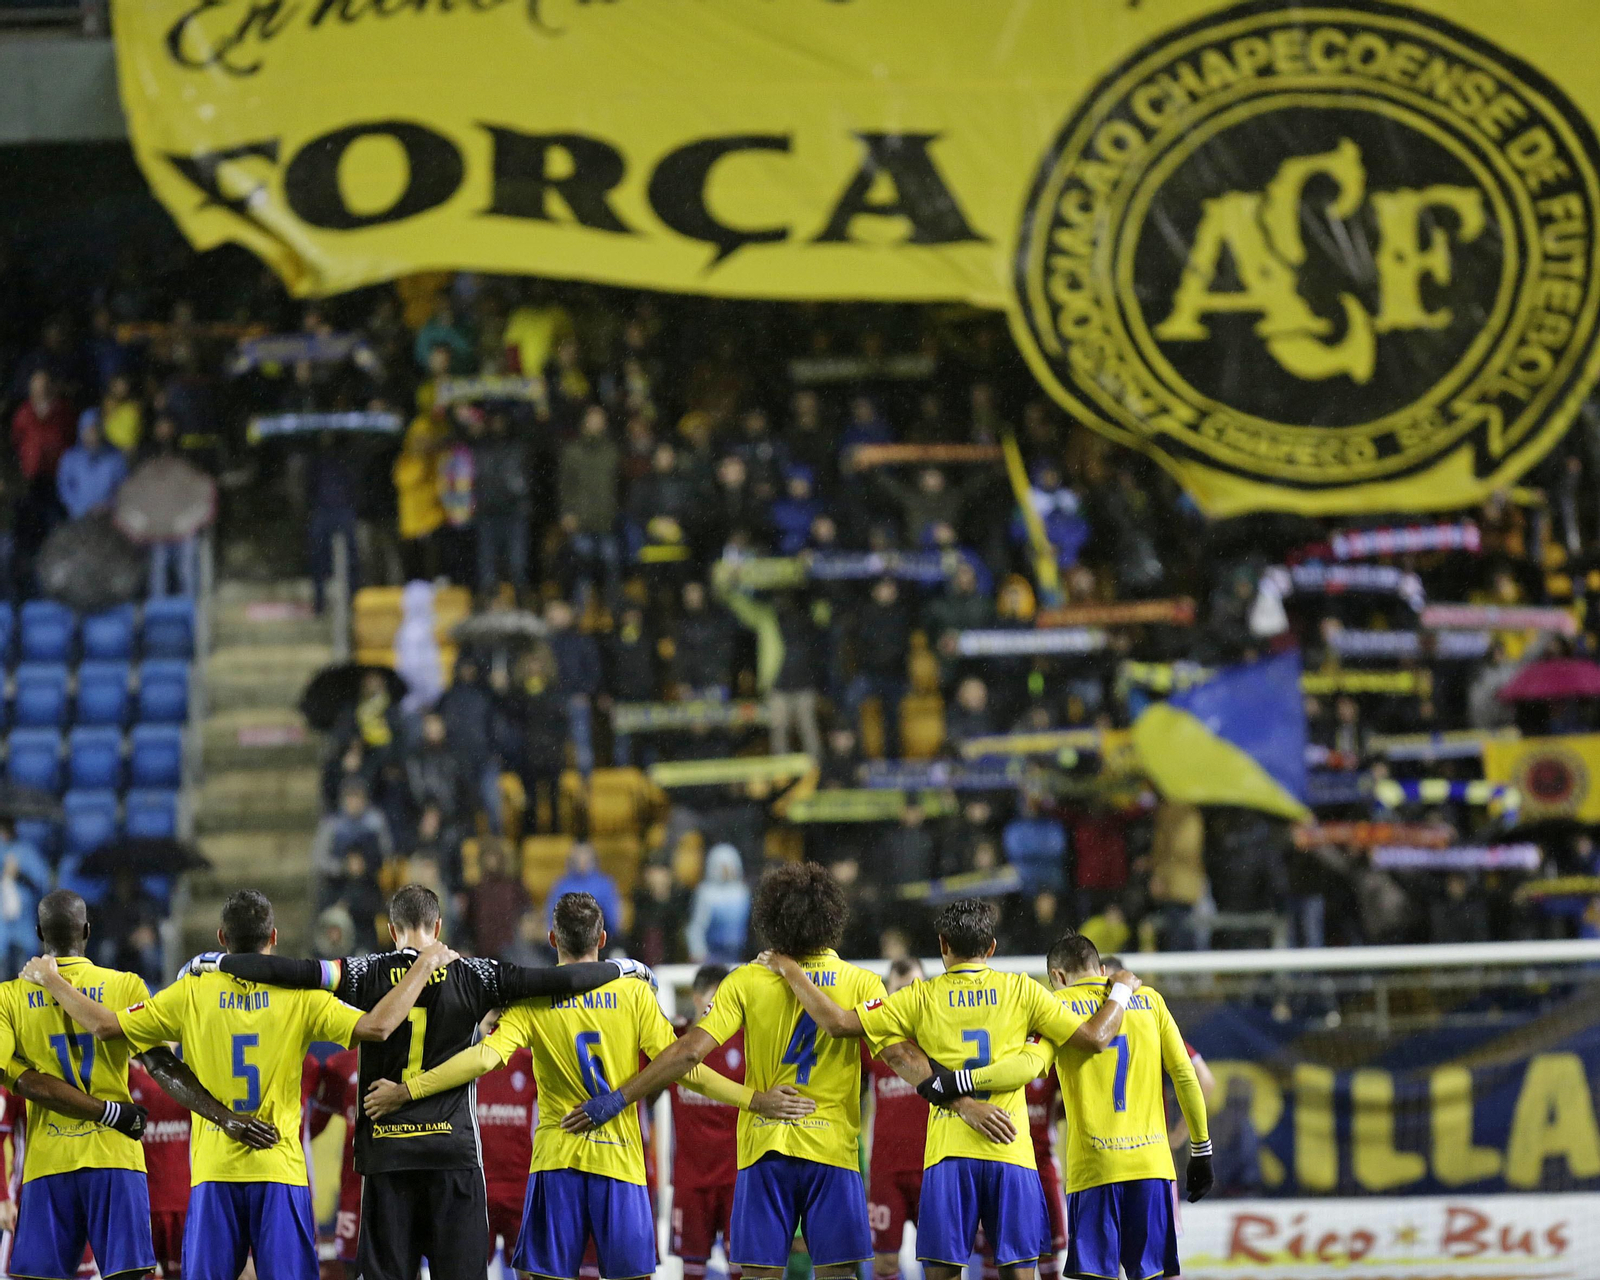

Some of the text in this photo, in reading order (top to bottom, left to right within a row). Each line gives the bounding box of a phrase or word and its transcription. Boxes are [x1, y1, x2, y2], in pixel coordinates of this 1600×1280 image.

[1133, 27, 1526, 138] CHAPECOENSE
[1505, 127, 1571, 195] DE
[158, 116, 992, 273] FORÇA
[27, 990, 48, 1009] KH.
[219, 991, 269, 1011] GARRIDO
[583, 992, 617, 1009] MARI
[949, 988, 998, 1008] CARPIO
[49, 1032, 95, 1095] 17
[231, 1033, 260, 1112] 5
[401, 1006, 427, 1083] 1
[575, 1030, 612, 1098] 6
[781, 1009, 818, 1086] 4
[1106, 1033, 1130, 1112] 7
[1227, 1206, 1570, 1263] Rico Bus
